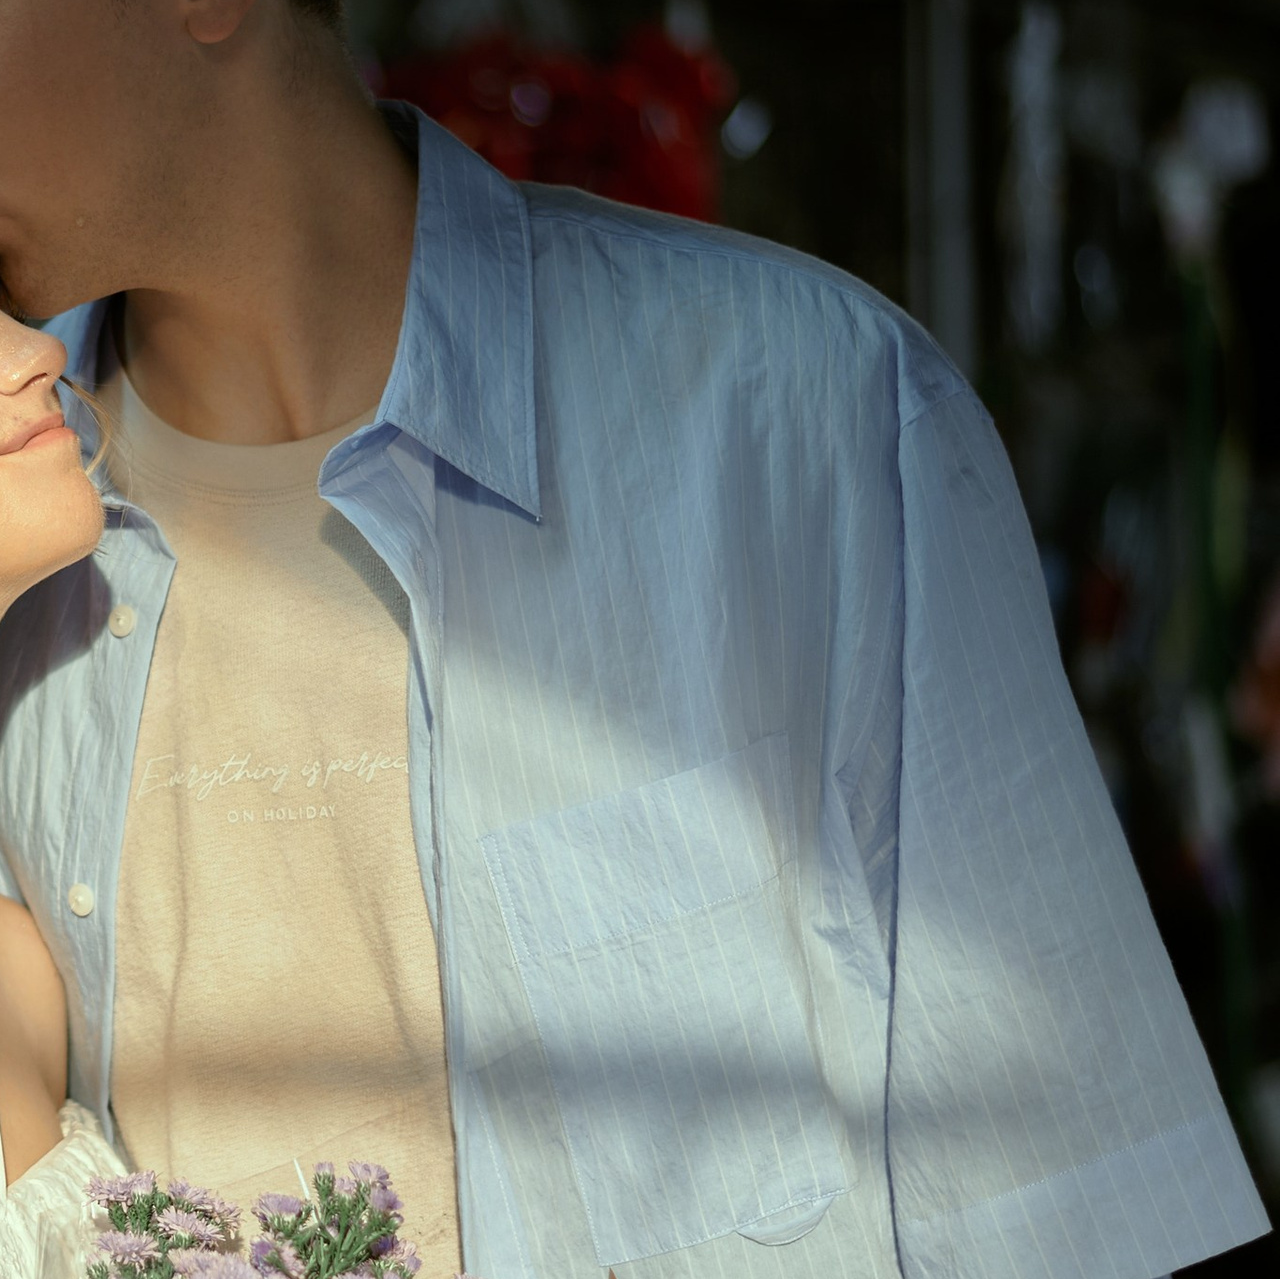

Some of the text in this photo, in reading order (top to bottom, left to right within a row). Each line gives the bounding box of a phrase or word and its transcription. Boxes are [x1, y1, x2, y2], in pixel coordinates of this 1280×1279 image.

[135, 752, 289, 801] Everything
[300, 759, 322, 788] is
[227, 804, 337, 823] ON HOLIDAY
